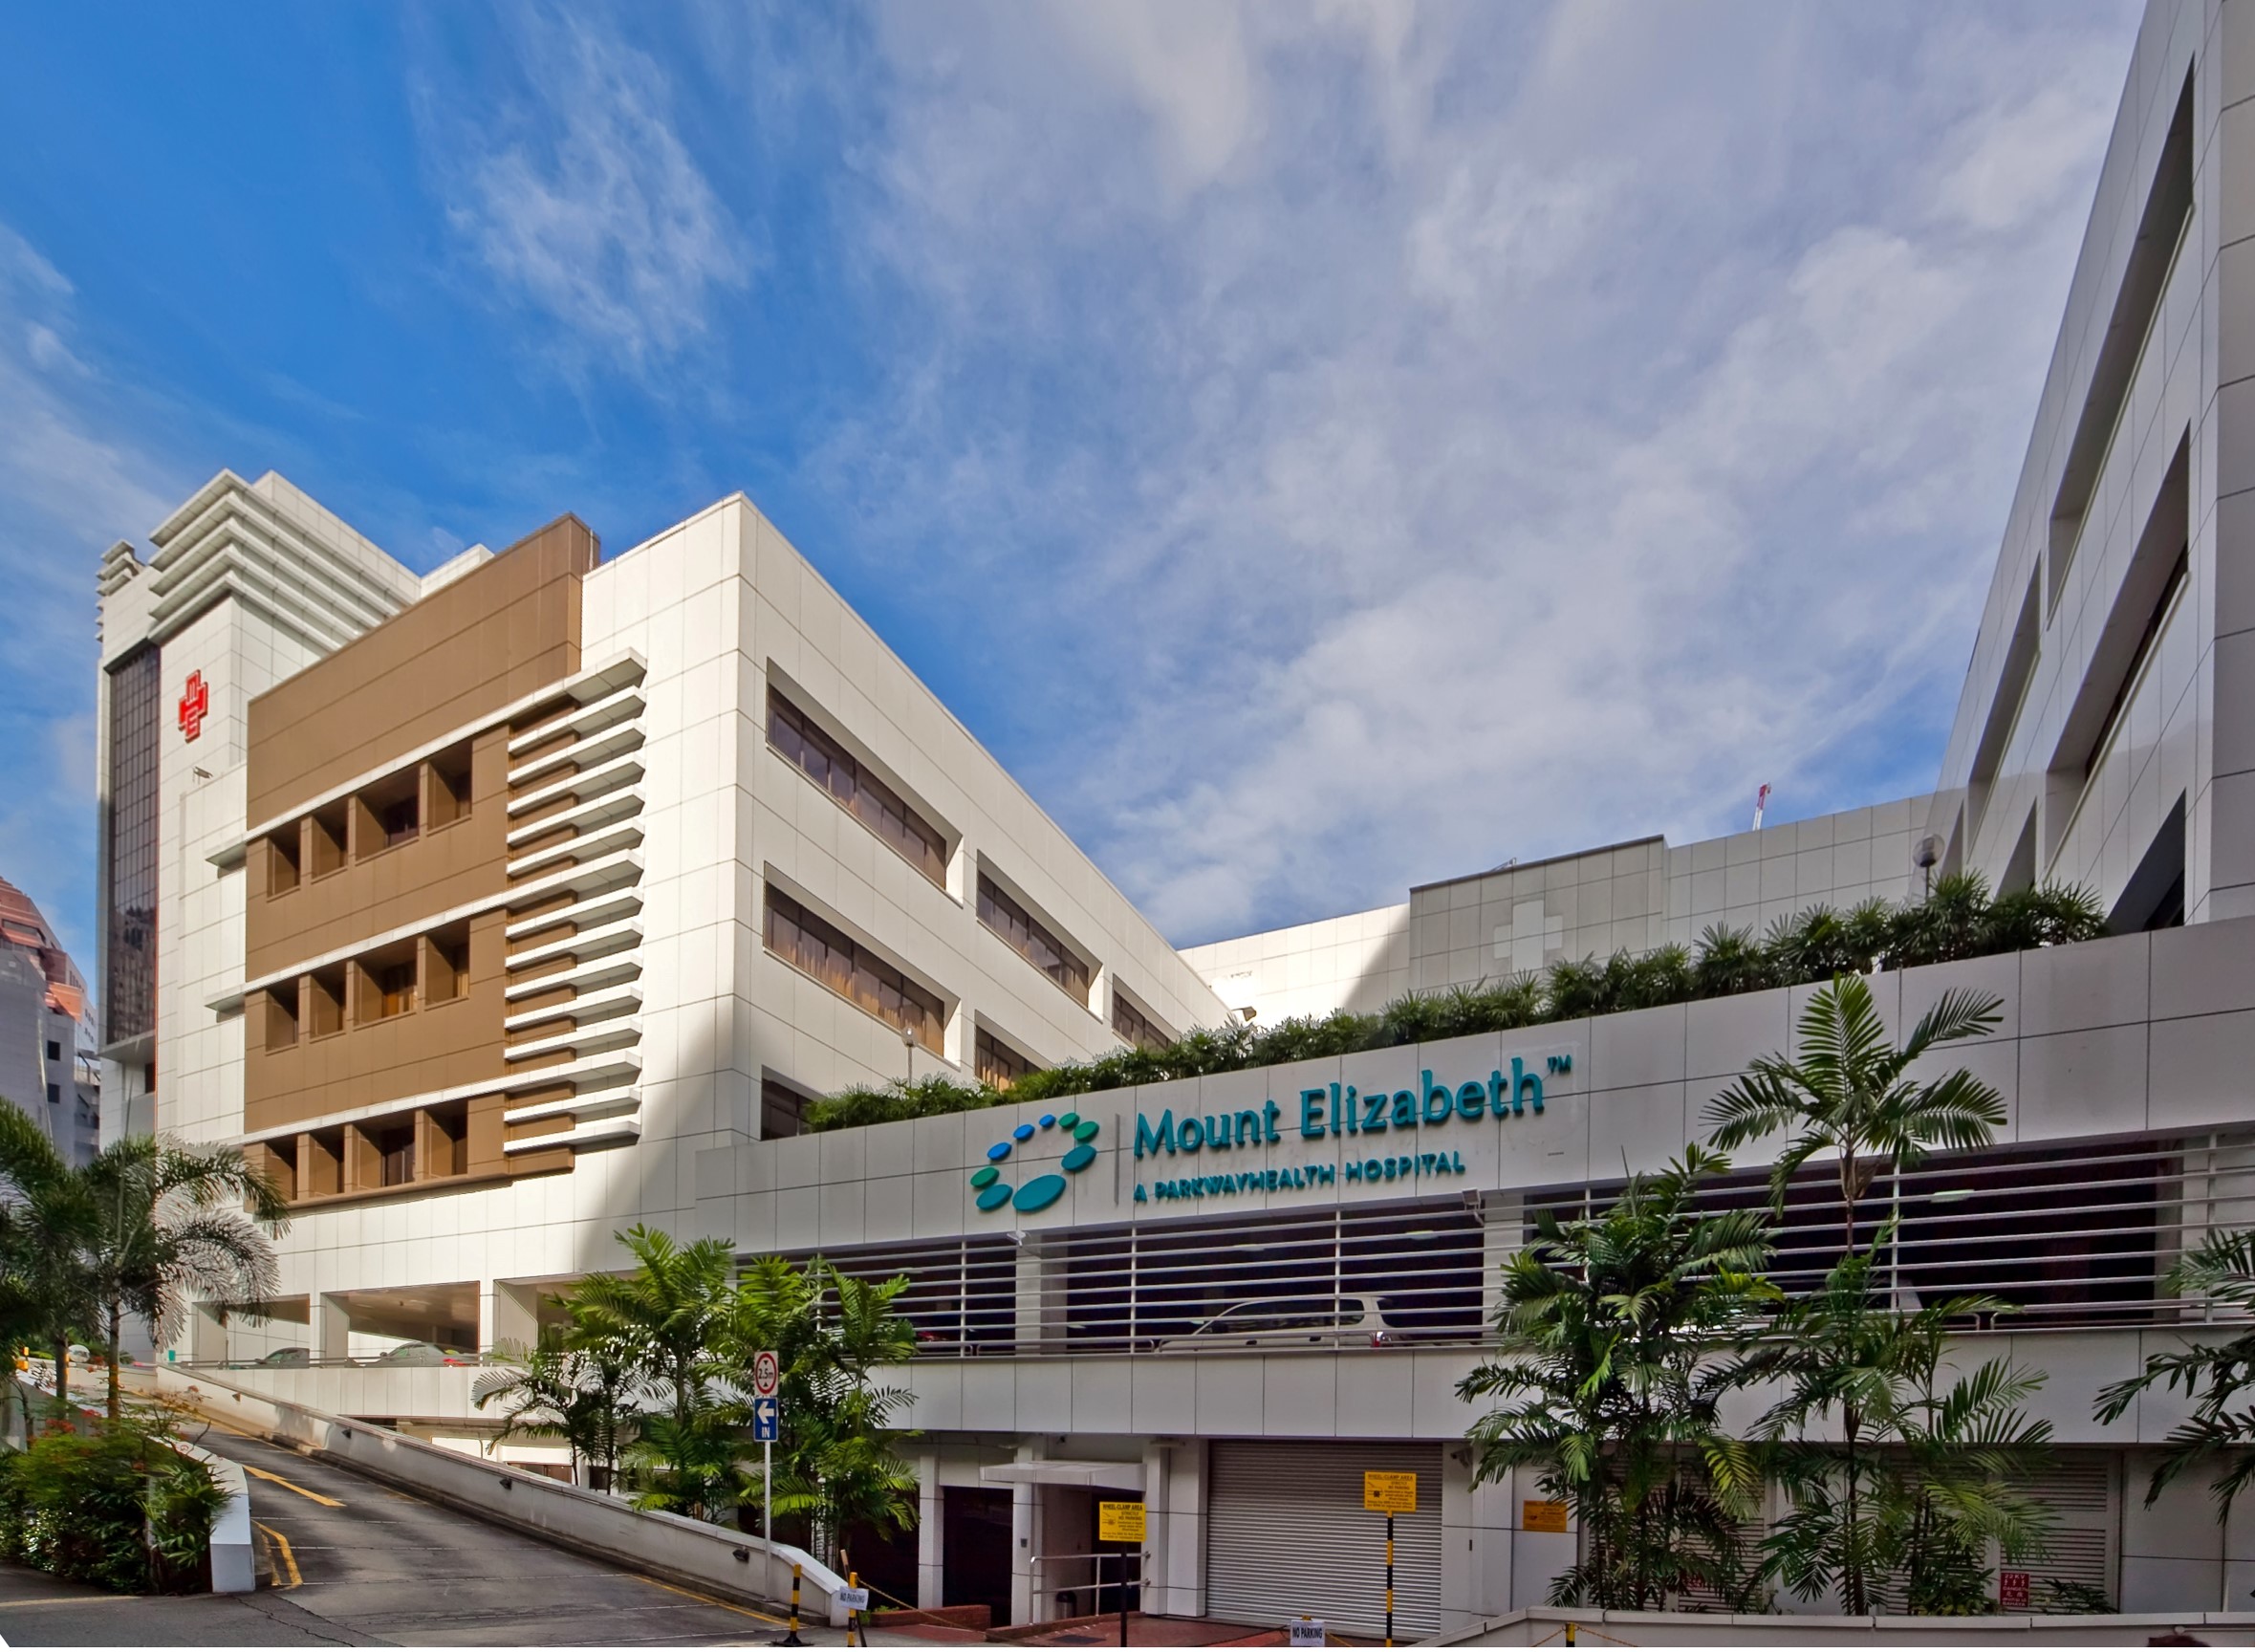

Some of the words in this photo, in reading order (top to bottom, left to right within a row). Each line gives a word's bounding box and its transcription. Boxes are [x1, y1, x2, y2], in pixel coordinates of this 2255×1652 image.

[1134, 1100, 1280, 1158] Mount
[1300, 1055, 1545, 1138] Elizabeth
[1133, 1183, 1147, 1202] A
[1154, 1163, 1335, 1199] PARKWAYHEALTH
[1345, 1150, 1465, 1181] HOSPITAL
[758, 1368, 774, 1380] 2.5m
[761, 1426, 770, 1439] IN
[840, 1592, 847, 1602] NO
[847, 1593, 865, 1603] PARKING
[1292, 1626, 1300, 1639] NO
[1301, 1626, 1323, 1640] PARKING
